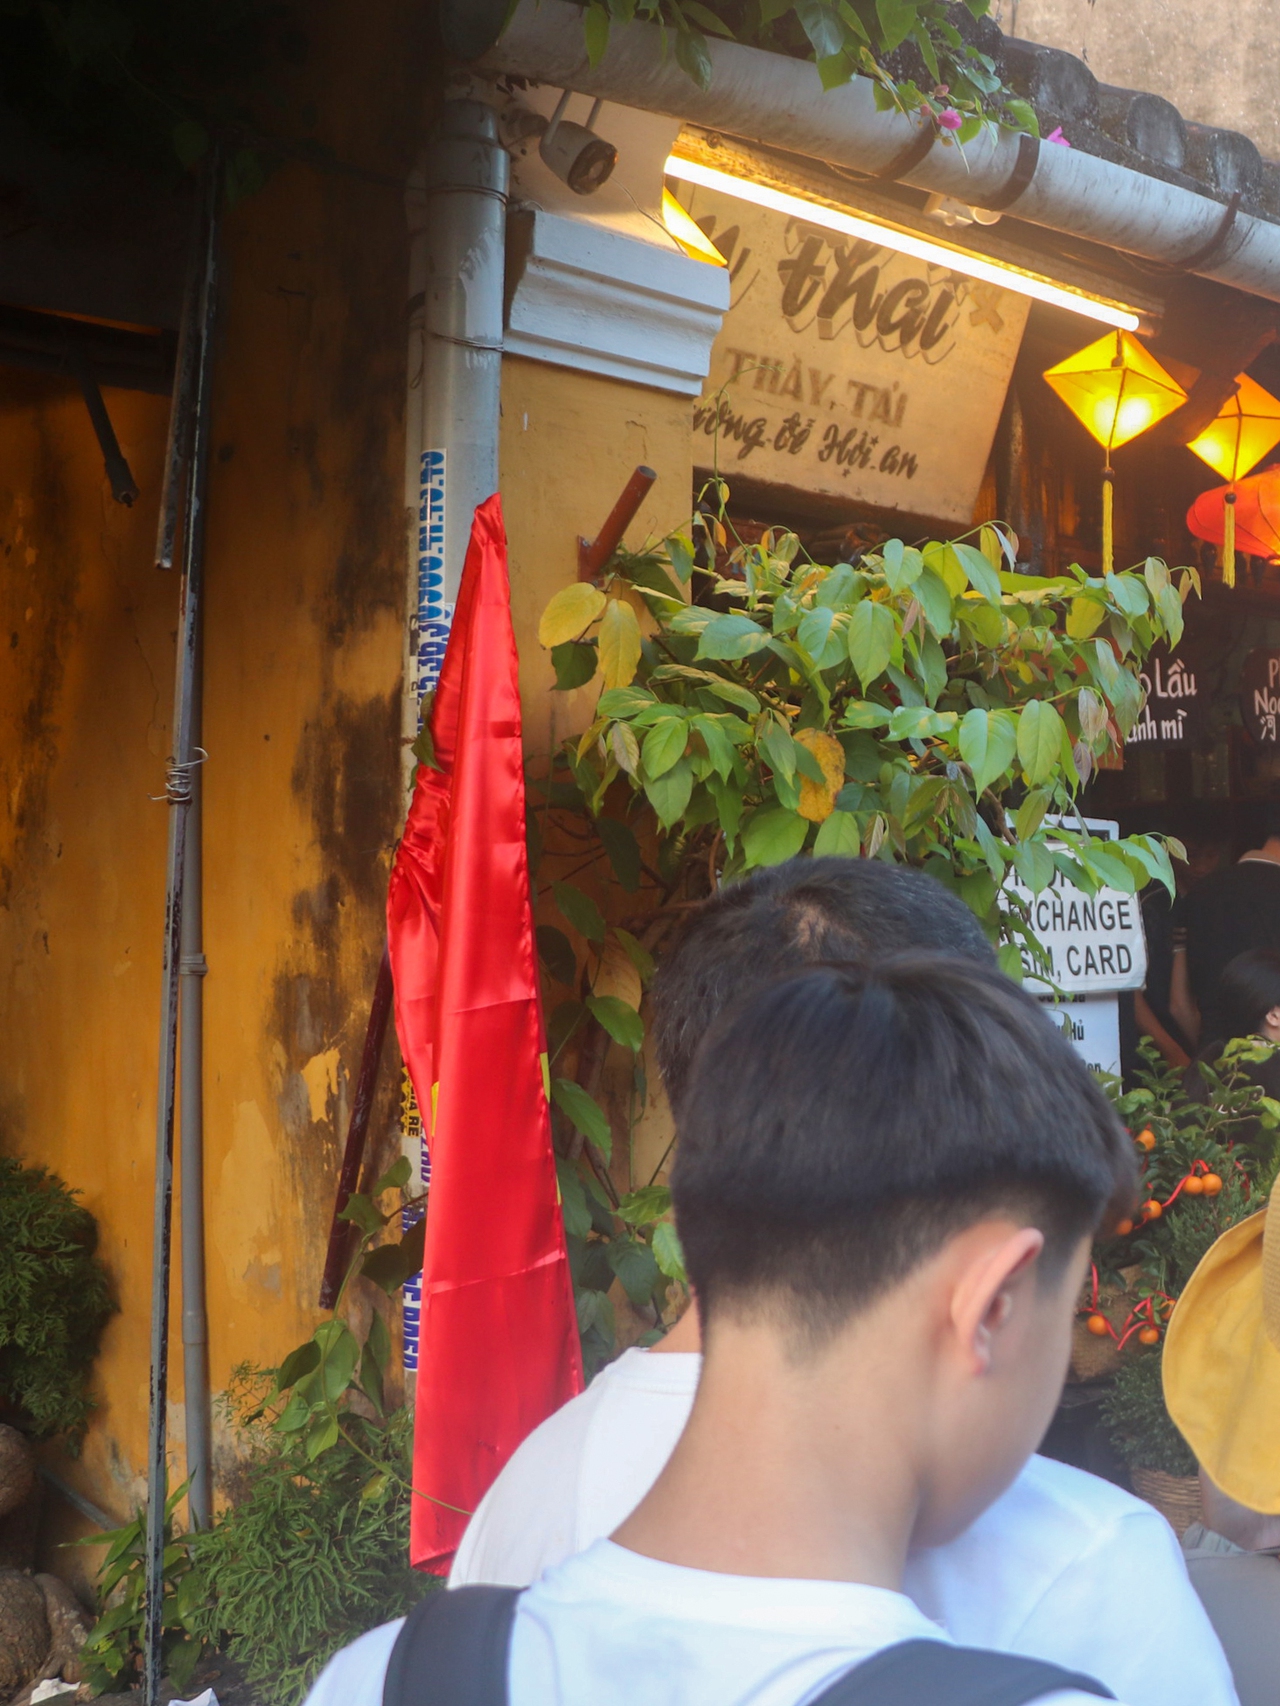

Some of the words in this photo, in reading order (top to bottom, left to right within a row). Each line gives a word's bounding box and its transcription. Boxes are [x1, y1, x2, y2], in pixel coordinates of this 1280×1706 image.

[1155, 658, 1198, 698] Lầu
[1126, 704, 1157, 742] anh
[1161, 708, 1188, 740] mì
[1066, 943, 1132, 976] CARD
